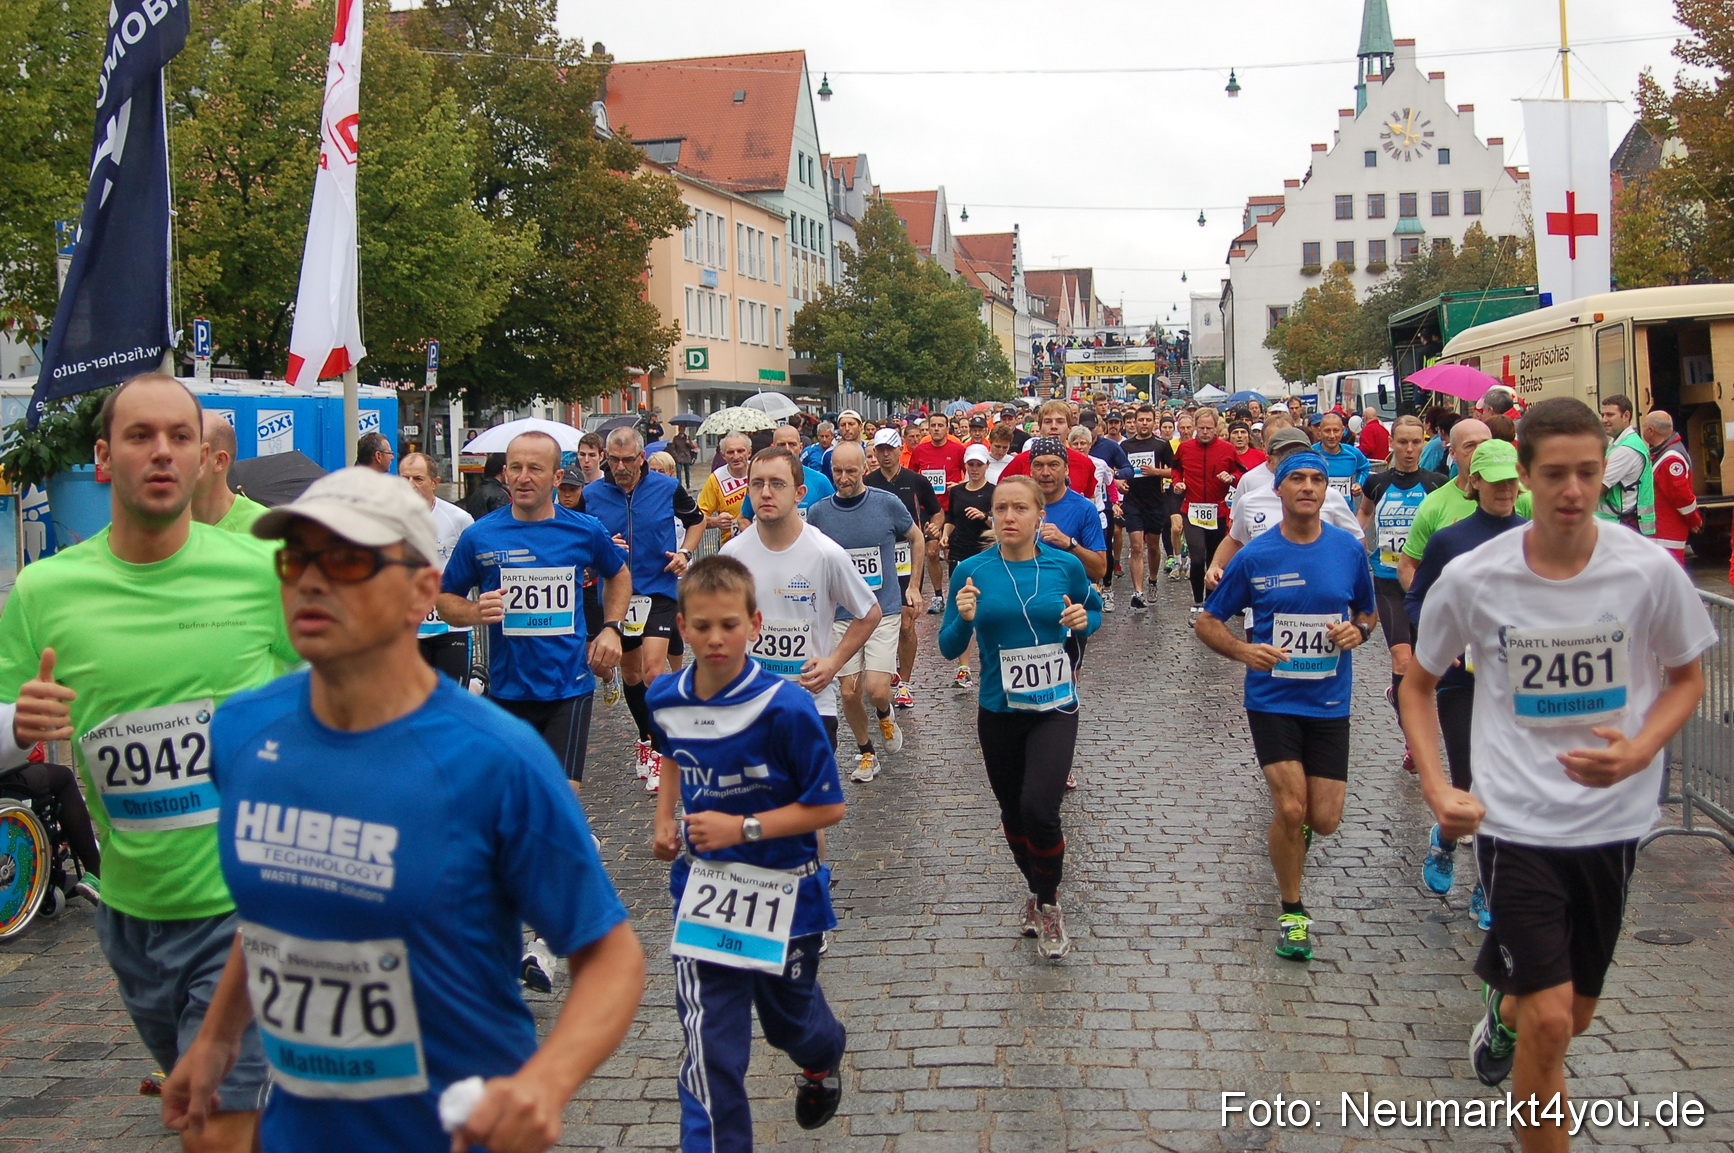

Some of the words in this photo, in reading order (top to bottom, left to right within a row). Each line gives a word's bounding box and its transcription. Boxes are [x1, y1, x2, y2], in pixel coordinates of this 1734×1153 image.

[198, 324, 207, 353] P
[689, 350, 705, 367] D
[1094, 365, 1125, 374] START
[1520, 344, 1570, 373] Bayerisches
[1520, 375, 1544, 394] Rotes
[1195, 509, 1212, 520] 186
[509, 584, 569, 610] 2610
[526, 616, 553, 627] Josef
[1275, 619, 1298, 627] PARTL
[752, 633, 806, 658] 2392
[1509, 639, 1549, 649] PARTL
[1551, 635, 1607, 648] Neumarkt
[761, 661, 794, 673] Damian
[1027, 650, 1056, 660] Neumarkt
[1292, 660, 1323, 670] Robert
[1009, 657, 1064, 689] 2017
[1521, 647, 1614, 690] 2461
[1028, 691, 1054, 702] Maria
[1536, 697, 1604, 714] Christian
[81, 726, 123, 744] PARTL
[126, 715, 191, 736] Neumarkt
[98, 732, 210, 788] 2942
[123, 791, 201, 815] Christoph
[235, 800, 399, 866] HUBER
[263, 847, 385, 883] TECHNOLOGY
[260, 868, 298, 885] WASTE
[301, 875, 338, 891] WATER
[692, 867, 727, 881] PARTL
[729, 873, 779, 892] Neumarkt
[691, 884, 781, 933] 2411
[716, 933, 743, 952] Jan
[243, 936, 284, 963] PARTL
[287, 953, 371, 974] Neumarkt
[260, 966, 396, 1038] 2776
[279, 1045, 377, 1077] Matthias
